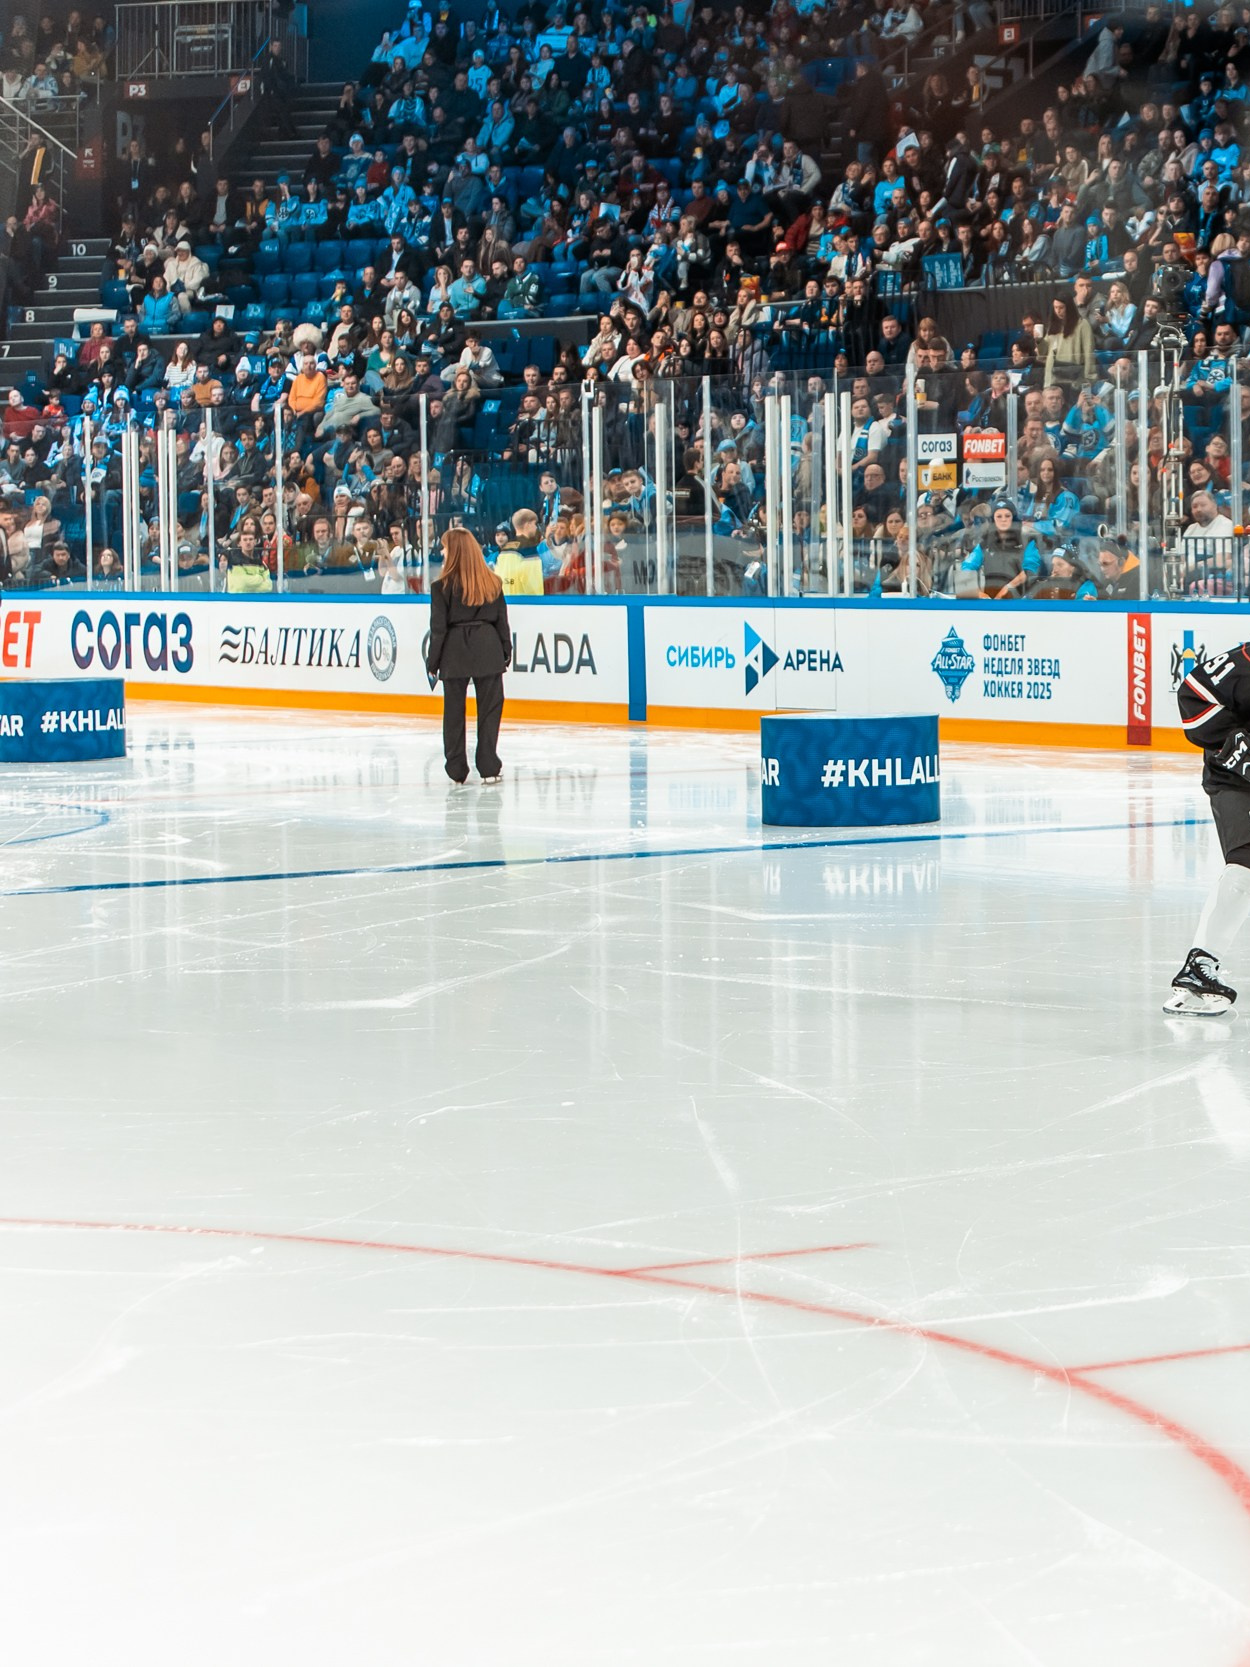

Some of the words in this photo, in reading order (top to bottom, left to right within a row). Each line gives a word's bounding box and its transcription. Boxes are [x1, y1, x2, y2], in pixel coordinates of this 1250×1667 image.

[129, 84, 146, 97] P3
[72, 243, 86, 256] 10
[48, 275, 58, 288] 9
[25, 310, 35, 322] 8
[1, 345, 10, 357] 7
[964, 439, 1005, 453] FONBET
[932, 472, 953, 481] БАНК
[0, 611, 42, 668] ET
[240, 626, 361, 668] БАЛТИКА
[983, 633, 1026, 651] ФОНБЕТ
[512, 632, 598, 675] LADA
[666, 645, 736, 669] СИБИРЬ
[783, 649, 844, 672] АРЕНА
[983, 657, 1024, 677] НЕДЕЛЯ
[1027, 658, 1061, 679] ЗВЕЗД
[1133, 619, 1146, 720] FONBET
[1203, 652, 1235, 686] 91
[983, 680, 1024, 699] ХОККЕЯ
[1026, 682, 1052, 700] 2025
[0, 714, 24, 737] AR
